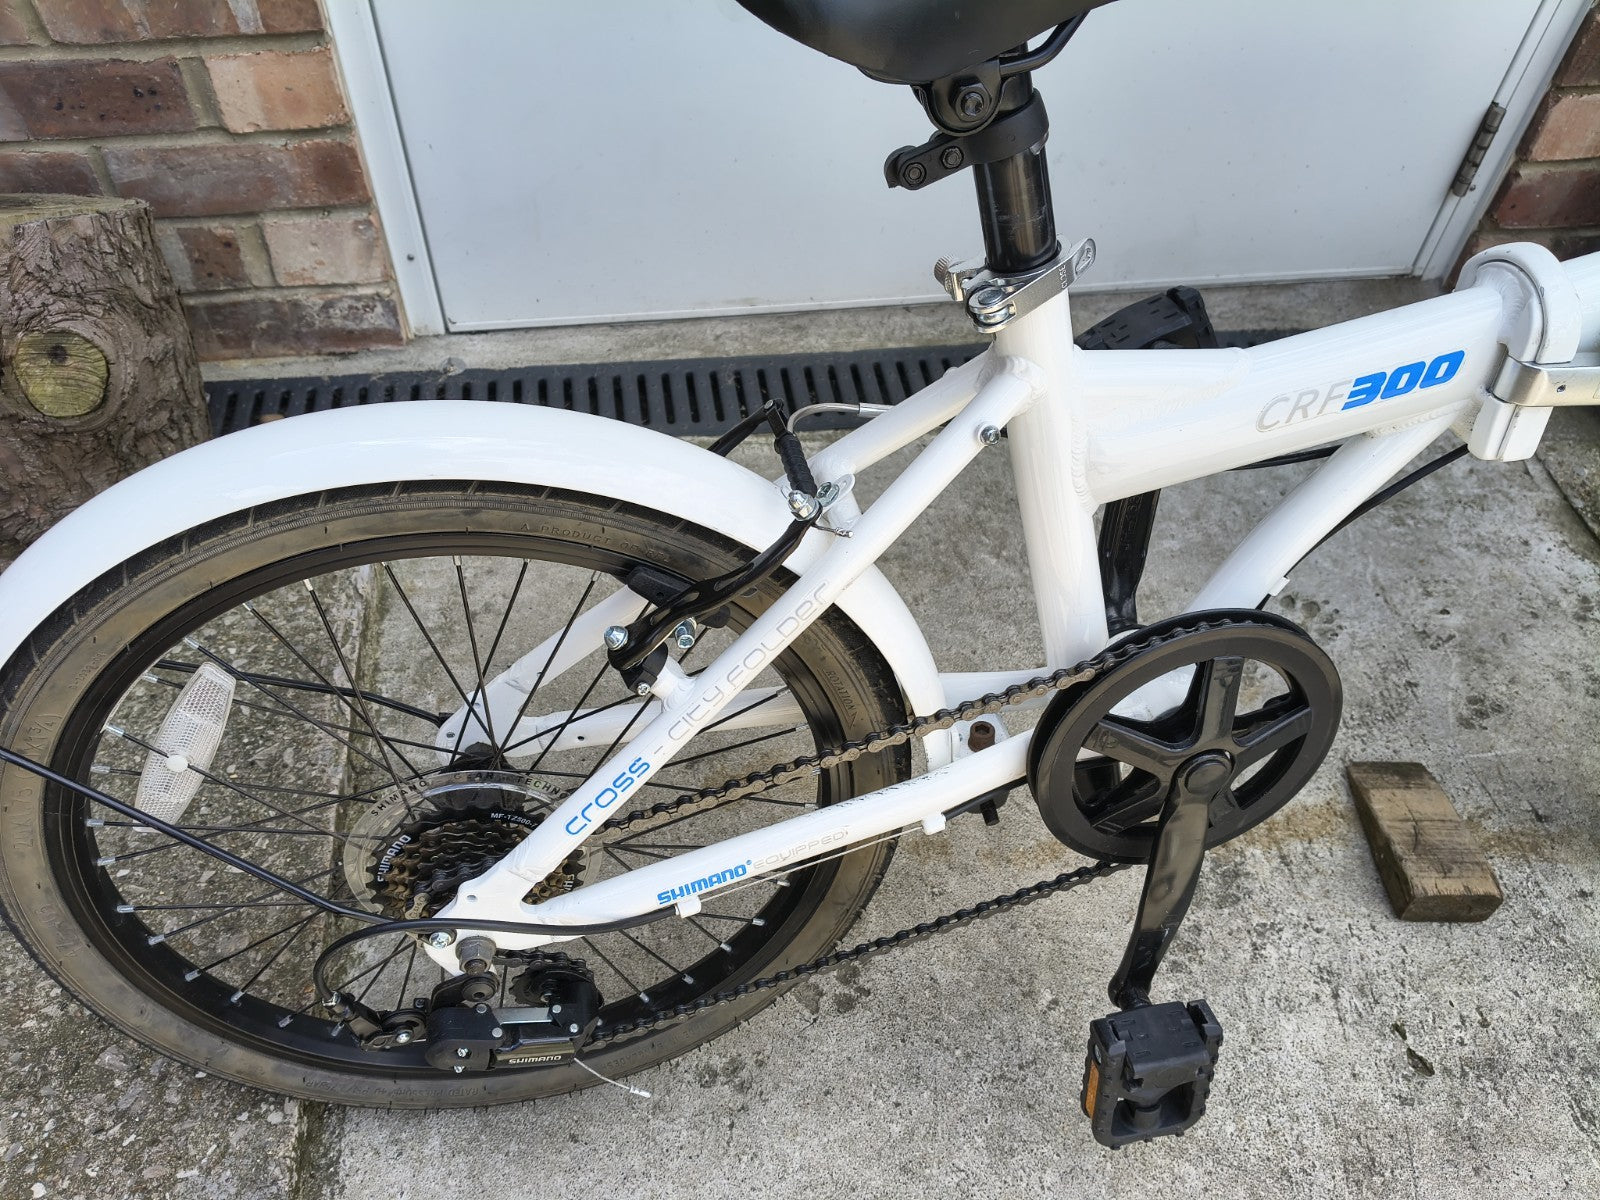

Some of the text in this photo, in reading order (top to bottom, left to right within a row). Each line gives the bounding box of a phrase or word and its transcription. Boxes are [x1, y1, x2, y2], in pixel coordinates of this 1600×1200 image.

[1257, 349, 1466, 431] CRF300
[540, 524, 611, 546] PRODUCT
[825, 670, 855, 713] ROTATION
[371, 780, 427, 817] SHIMANO
[377, 834, 412, 883] SHIMANO
[508, 1055, 562, 1065] SHIMANO
